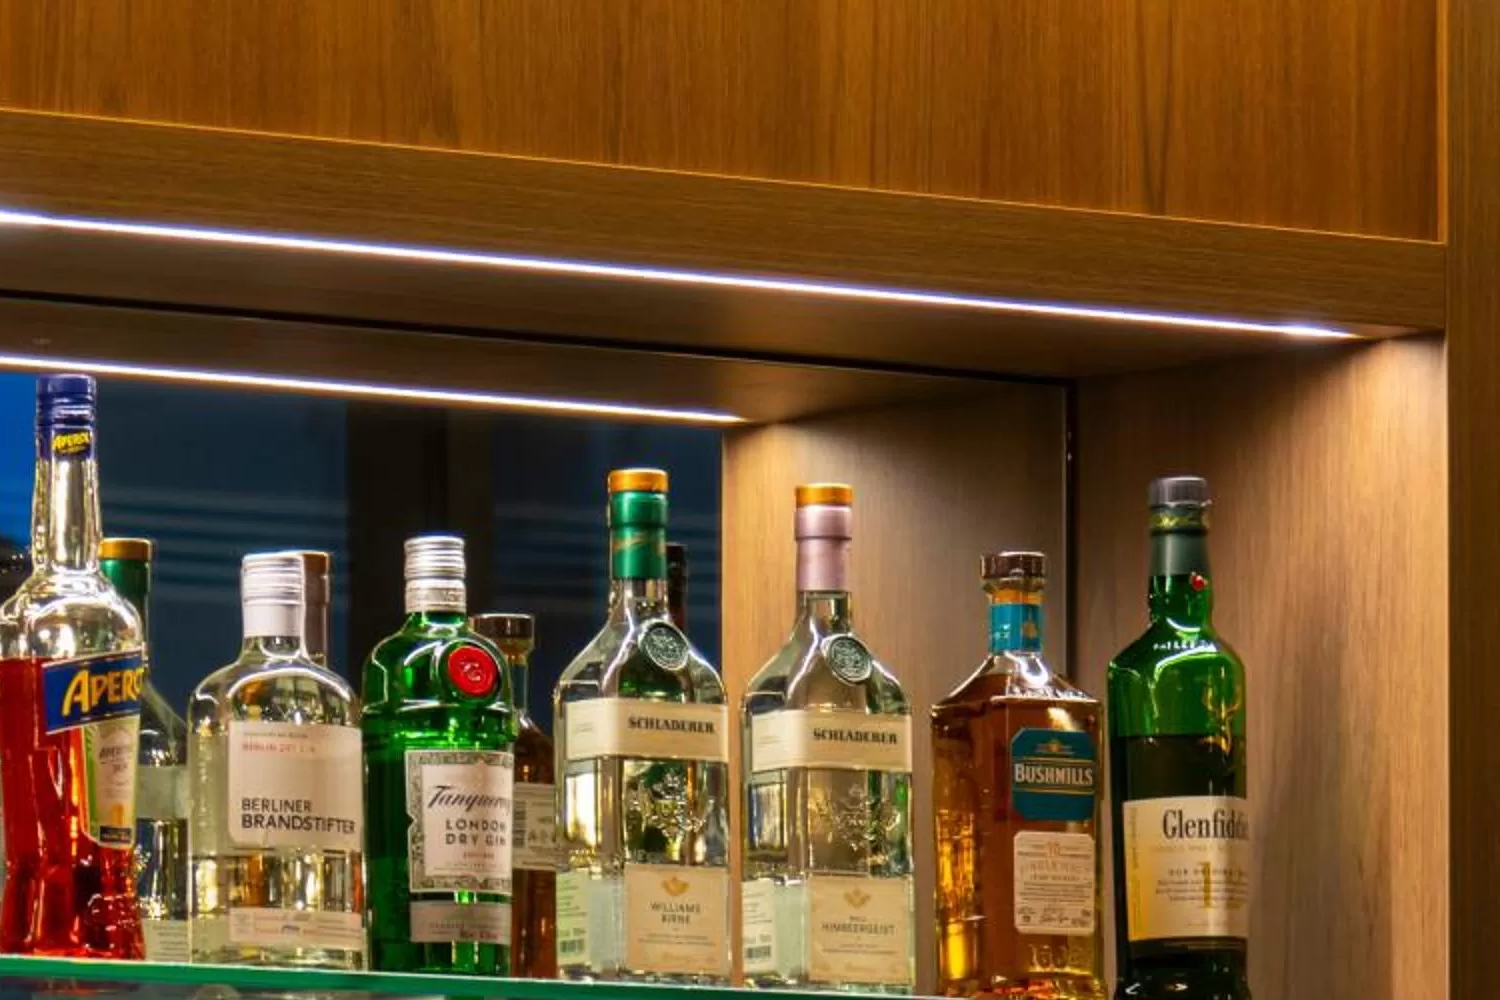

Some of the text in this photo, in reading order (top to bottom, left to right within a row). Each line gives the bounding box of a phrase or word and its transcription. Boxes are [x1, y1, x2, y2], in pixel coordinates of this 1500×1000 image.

[1014, 763, 1093, 785] BUSHMILLS
[241, 798, 312, 813] BERLINER
[241, 814, 356, 834] BRANDSTIFTER
[445, 833, 478, 846] DRY
